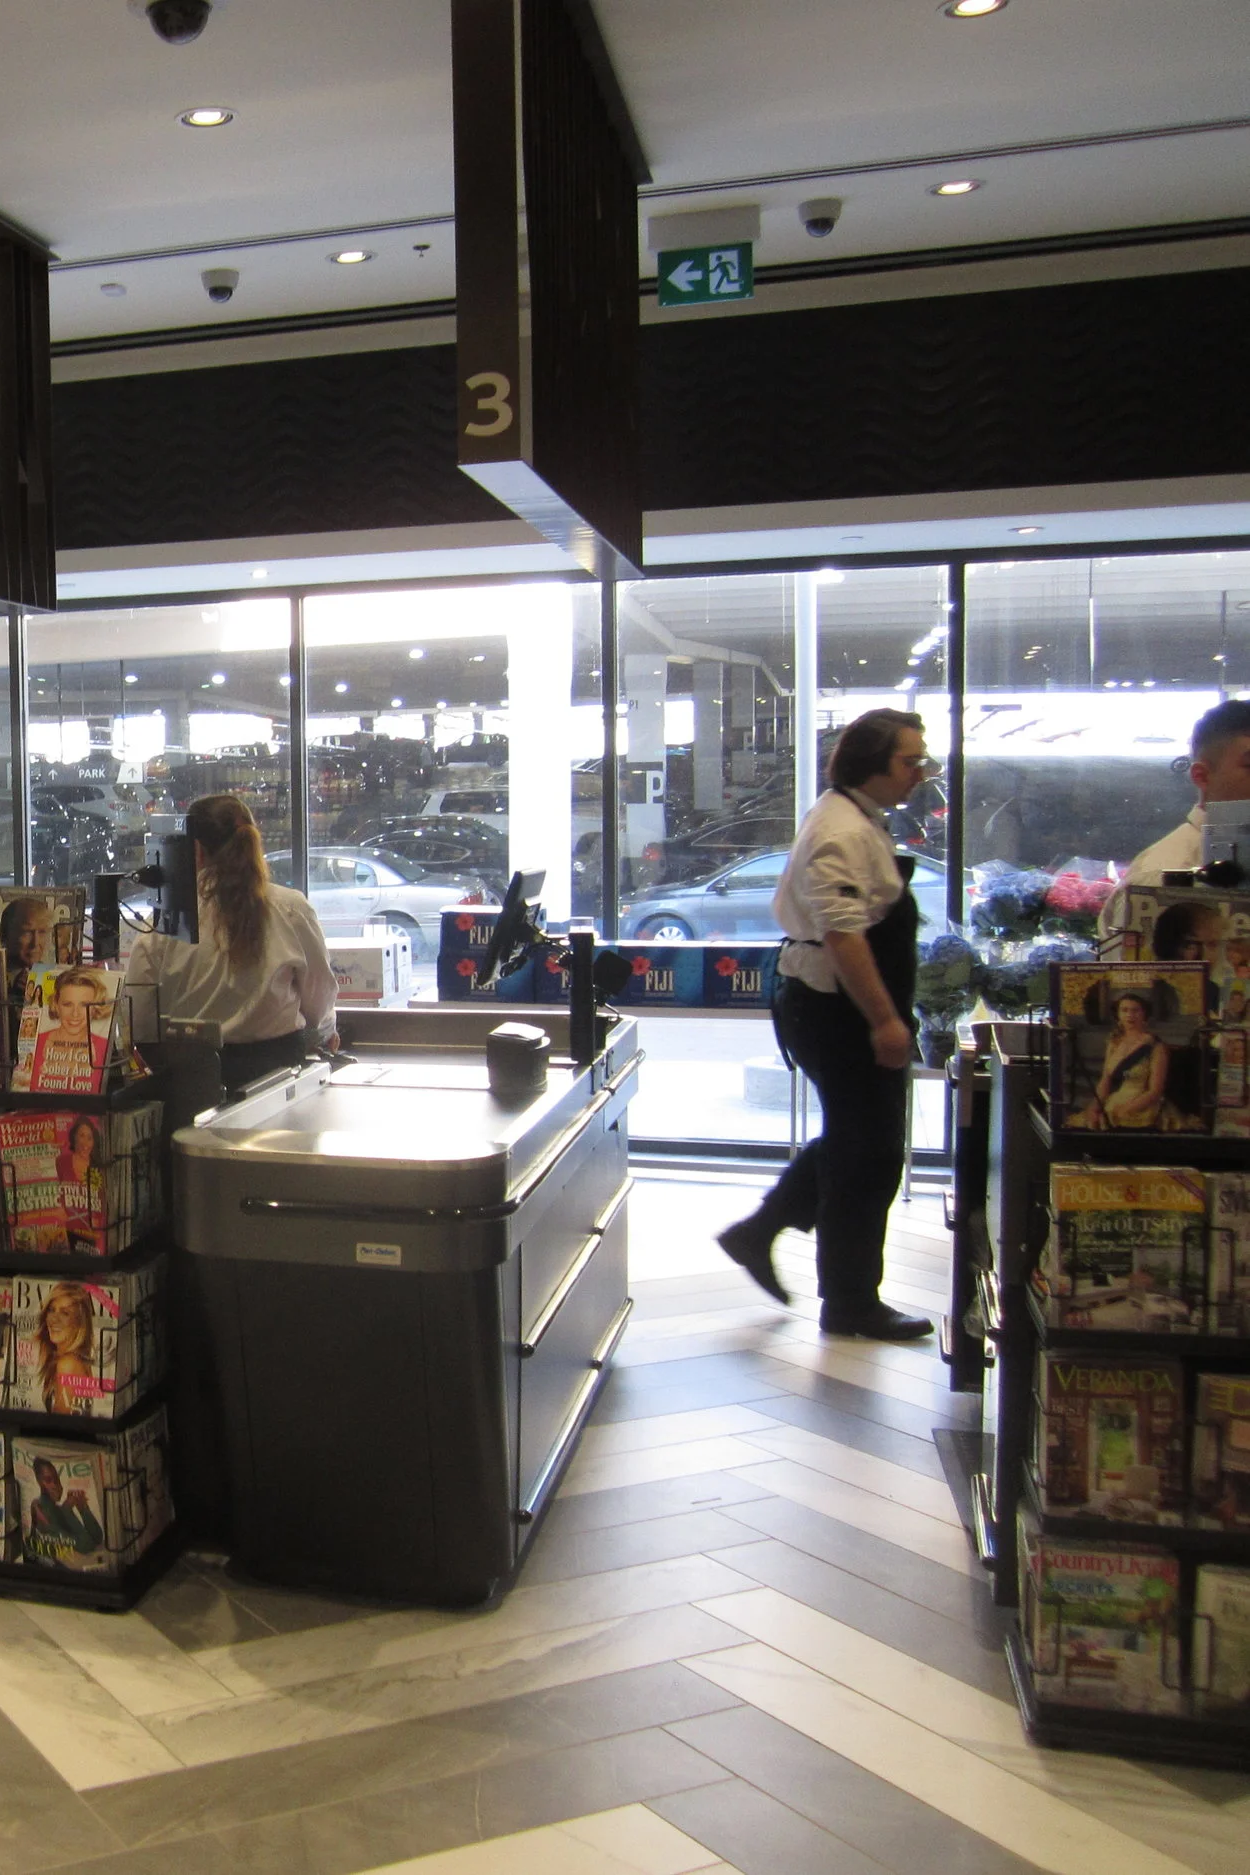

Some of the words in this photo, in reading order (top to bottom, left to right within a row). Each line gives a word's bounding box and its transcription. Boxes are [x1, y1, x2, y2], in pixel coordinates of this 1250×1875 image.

[464, 372, 513, 436] 3
[79, 769, 106, 778] PARK
[646, 771, 664, 804] P
[645, 970, 674, 992] FIJI
[732, 970, 762, 992] FIJI
[45, 1047, 67, 1062] How
[70, 1063, 92, 1077] And
[38, 1075, 67, 1090] Found
[70, 1075, 92, 1091] Love
[1, 1131, 41, 1146] World
[1062, 1184, 1123, 1204] HOUSE
[1124, 1185, 1139, 1203] &
[1141, 1185, 1201, 1206] HOME
[1053, 1364, 1175, 1392] VERANDA
[1041, 1549, 1117, 1577] Country
